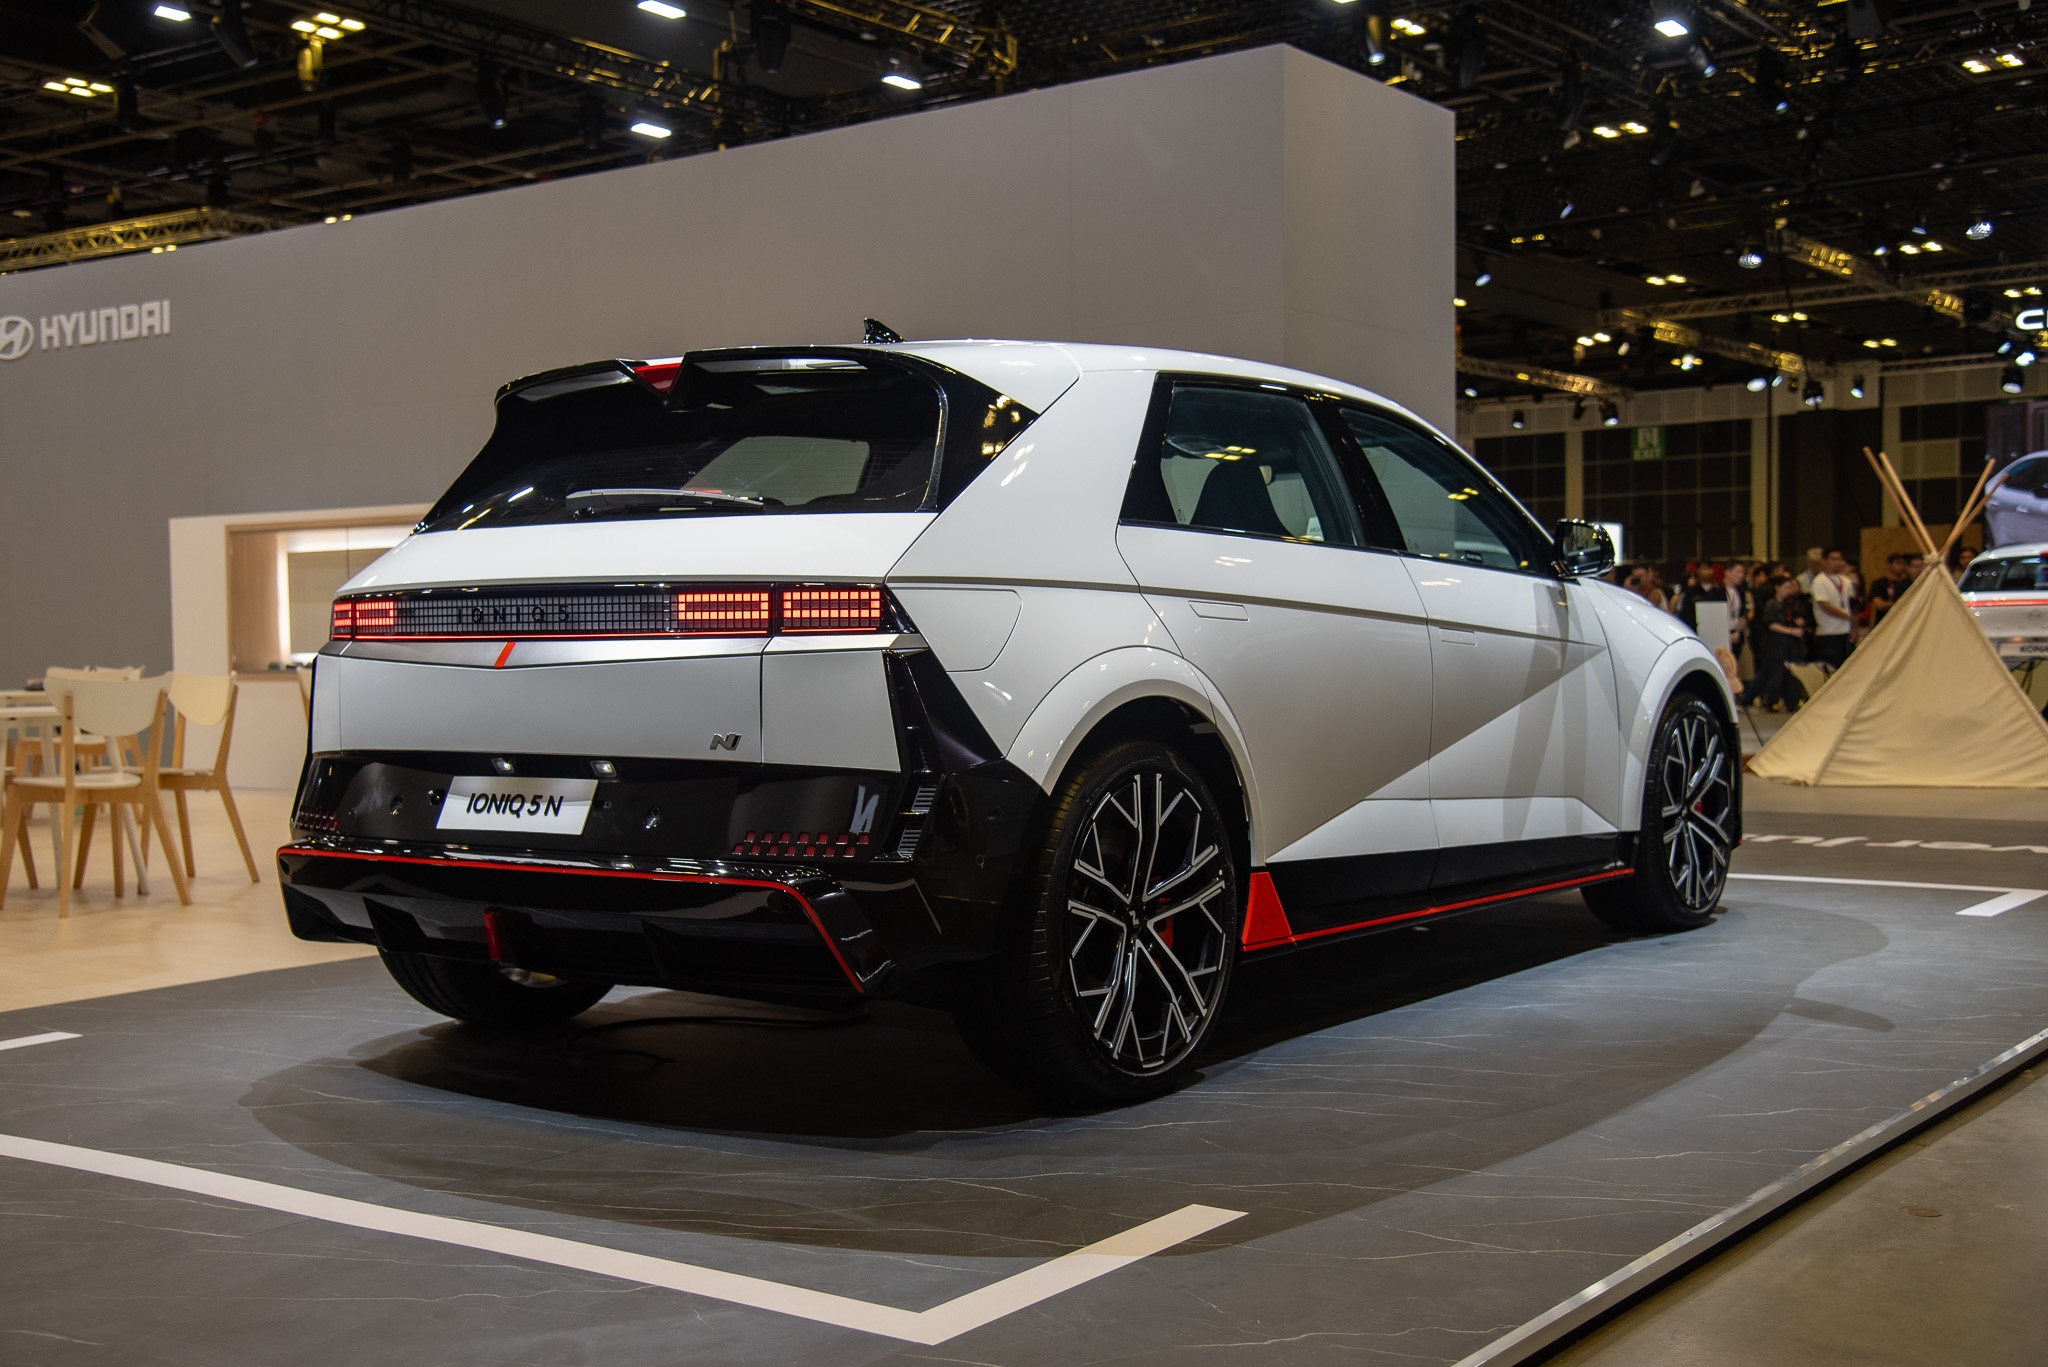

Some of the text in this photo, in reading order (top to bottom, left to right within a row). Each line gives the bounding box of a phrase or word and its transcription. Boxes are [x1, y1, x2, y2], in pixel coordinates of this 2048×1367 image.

[40, 299, 171, 350] HYUNDAI
[1633, 448, 1662, 461] EXIT
[466, 792, 564, 818] IONIQ 5 N
